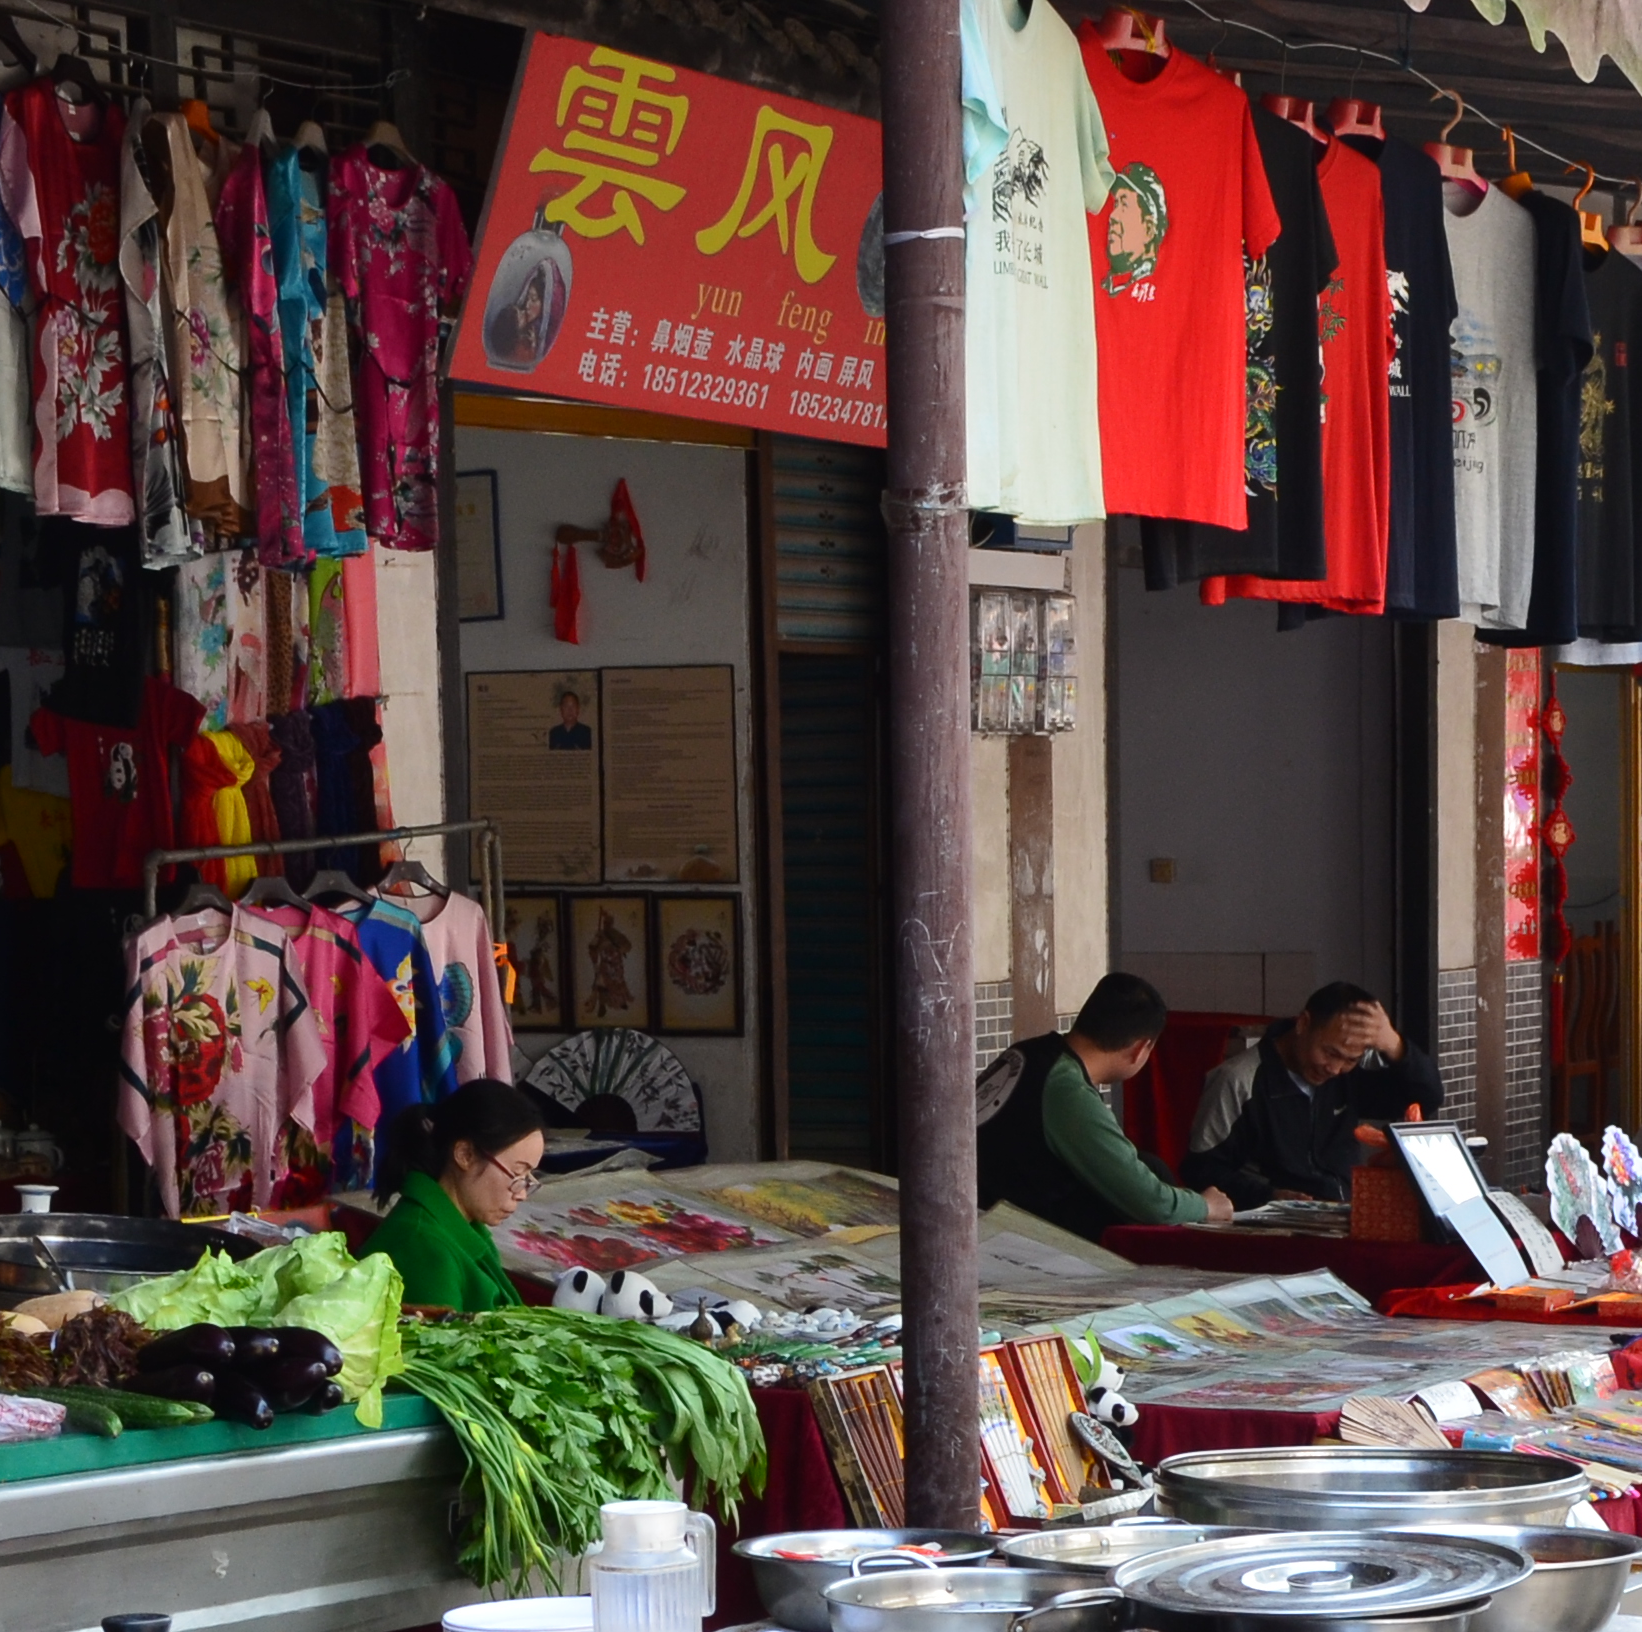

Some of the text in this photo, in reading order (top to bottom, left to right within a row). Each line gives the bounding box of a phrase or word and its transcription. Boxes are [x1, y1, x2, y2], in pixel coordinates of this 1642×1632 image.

[528, 45, 837, 284] 雲风
[691, 283, 743, 320] yun
[777, 290, 833, 345] feng
[651, 319, 715, 361] 鼻烟壶
[725, 334, 786, 374] 水晶球
[643, 363, 770, 410] 18512329361
[789, 390, 887, 429] 185234781
[1389, 385, 1411, 397] WALL
